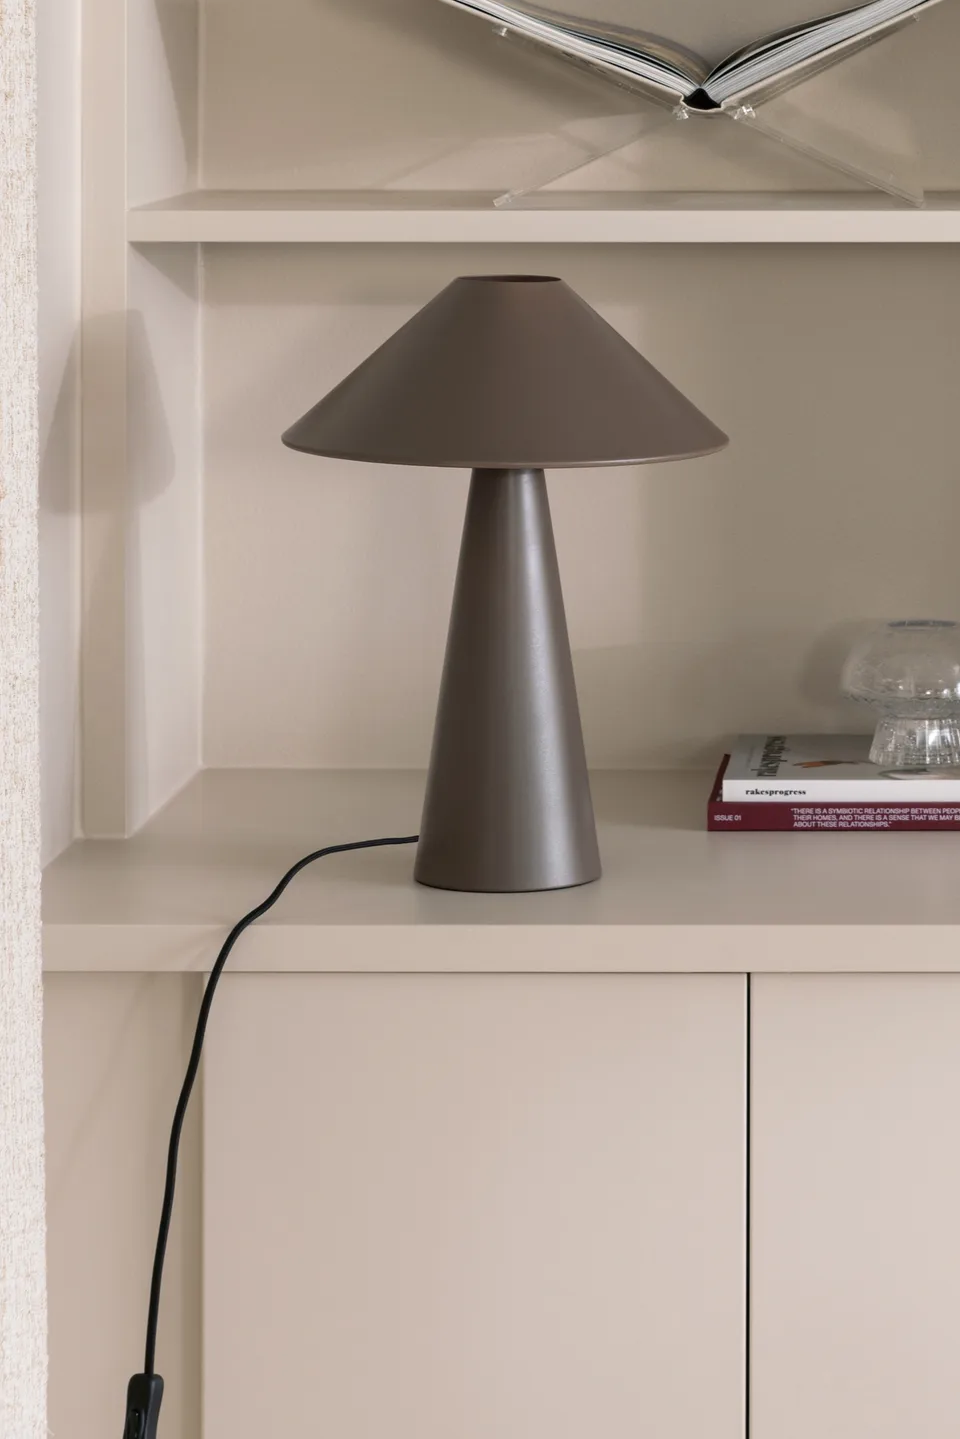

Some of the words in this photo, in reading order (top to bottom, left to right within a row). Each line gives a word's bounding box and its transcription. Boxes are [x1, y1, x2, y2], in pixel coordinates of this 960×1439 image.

[745, 788, 807, 796] rakesprogress
[714, 814, 734, 822] ISSUE
[734, 814, 742, 822] 01
